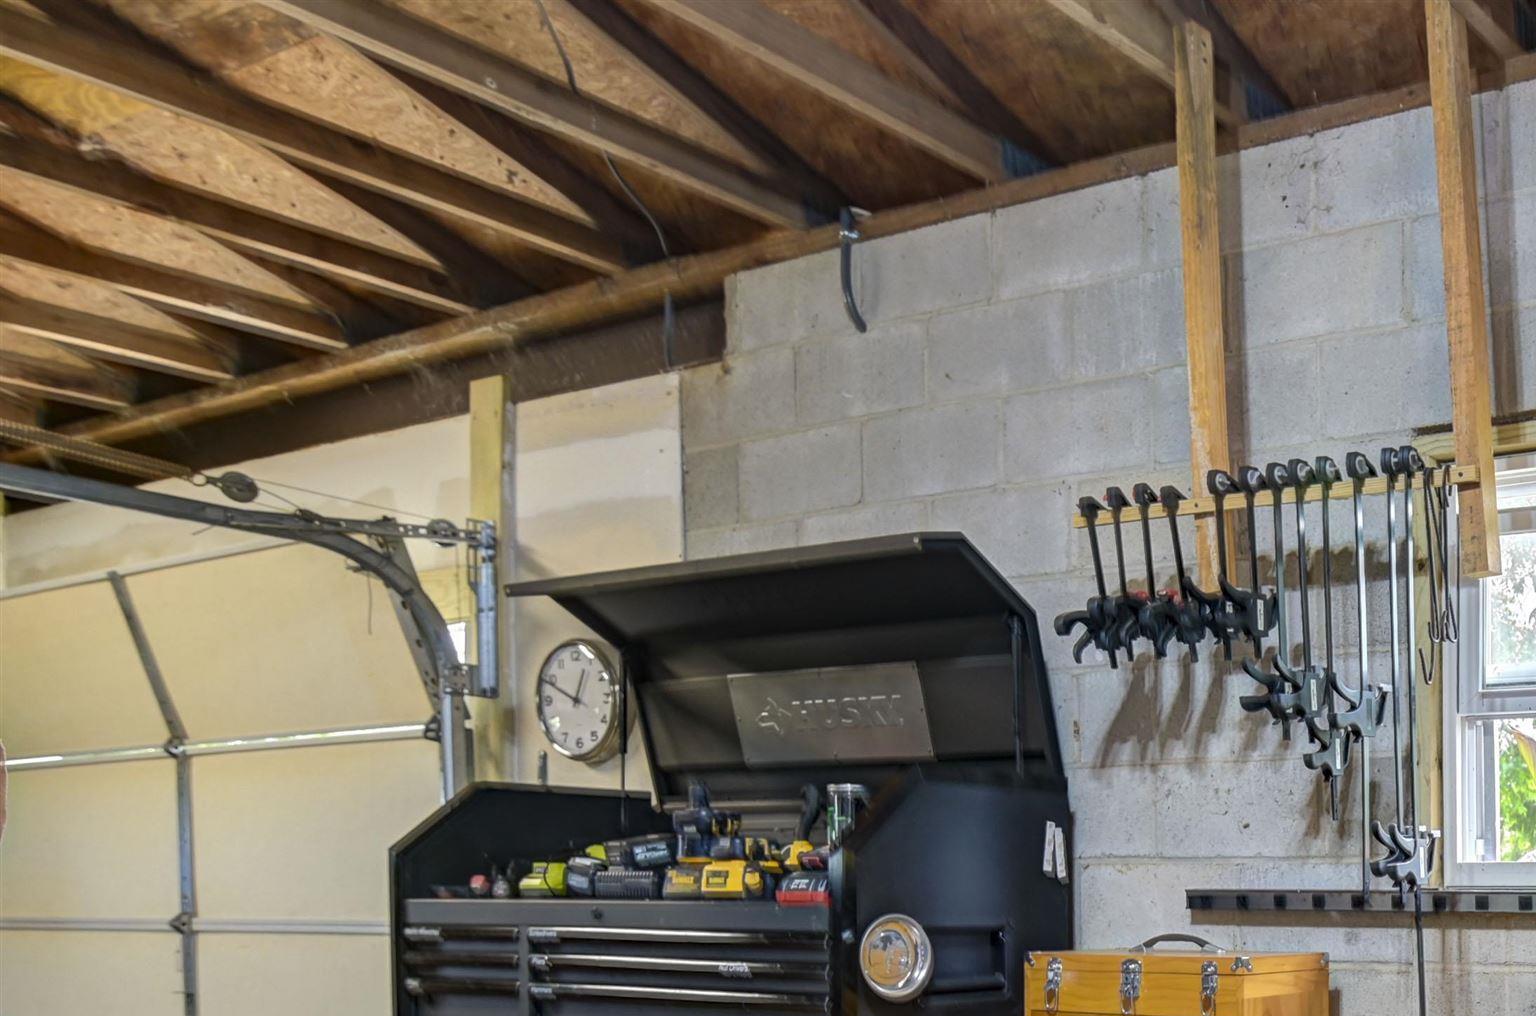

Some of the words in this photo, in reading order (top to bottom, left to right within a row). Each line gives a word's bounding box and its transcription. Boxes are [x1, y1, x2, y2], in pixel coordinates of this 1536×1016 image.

[544, 695, 553, 706] 9
[590, 730, 599, 742] 5
[575, 738, 584, 749] 6
